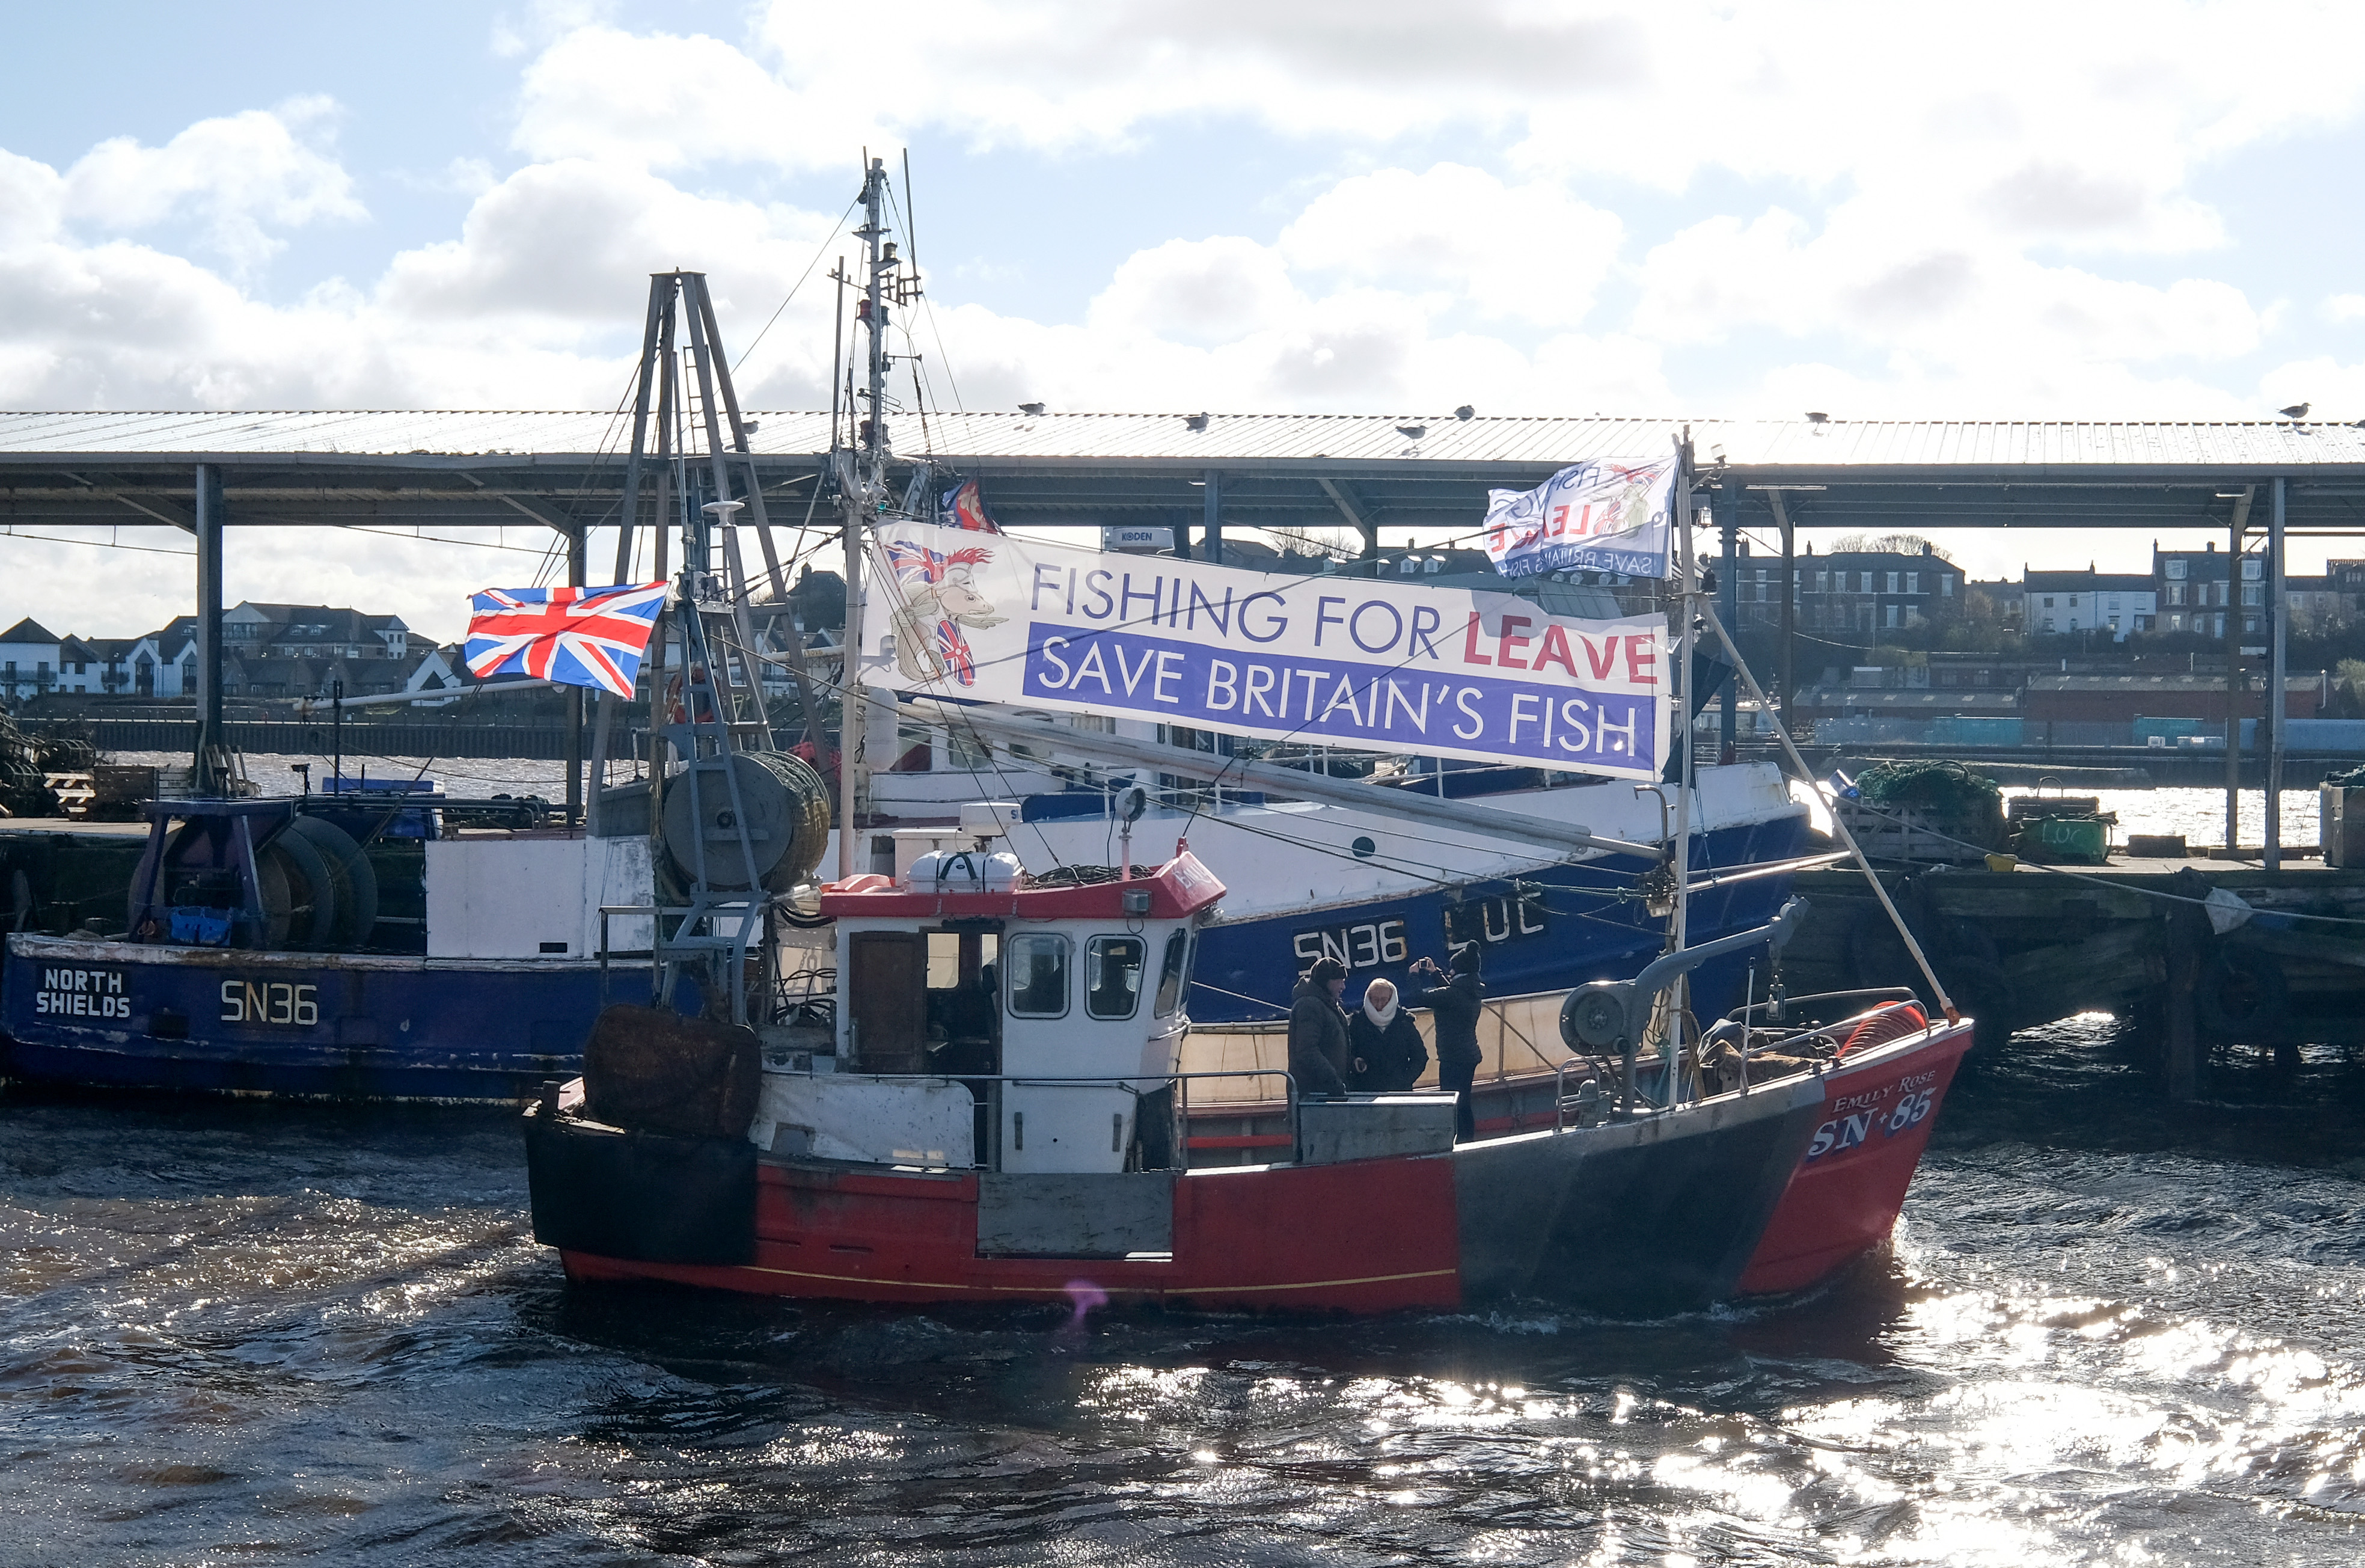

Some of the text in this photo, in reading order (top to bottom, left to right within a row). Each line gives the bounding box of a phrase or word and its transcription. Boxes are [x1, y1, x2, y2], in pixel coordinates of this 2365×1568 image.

[1122, 532, 1152, 542] KODEN
[1031, 562, 1658, 685] FISHING FOR LEAVE
[1038, 635, 1636, 758] SAVE BRITAIN'S FISH
[1293, 919, 1407, 976] SN36
[44, 969, 122, 994] NORTH
[221, 981, 317, 1026] SN36
[36, 991, 130, 1018] SHIELDS
[1832, 1070, 1936, 1113] EMILY ROSE
